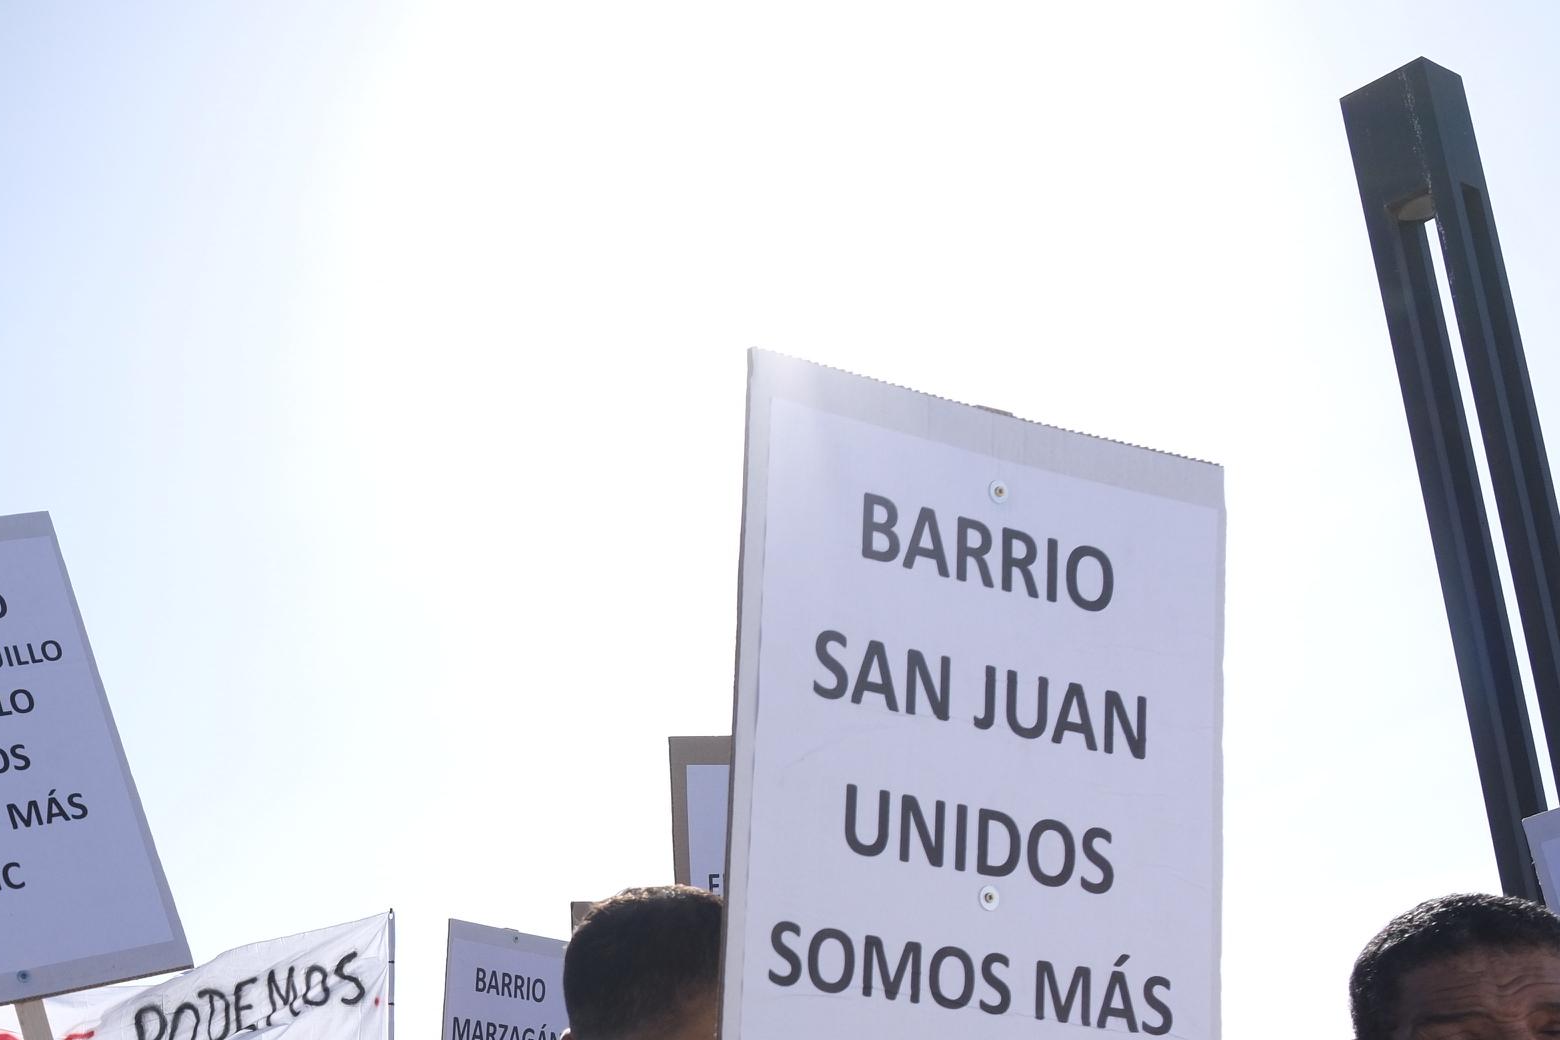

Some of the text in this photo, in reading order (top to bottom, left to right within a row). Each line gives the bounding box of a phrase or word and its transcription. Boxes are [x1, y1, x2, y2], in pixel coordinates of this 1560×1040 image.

[861, 492, 1114, 612] BARRIO
[812, 629, 1147, 760] SAN JUAN
[6, 788, 88, 830] MÁS
[844, 783, 1115, 895] UNIDOS
[475, 967, 546, 1003] BARRIO
[768, 920, 1173, 1036] SOMOS MÁS
